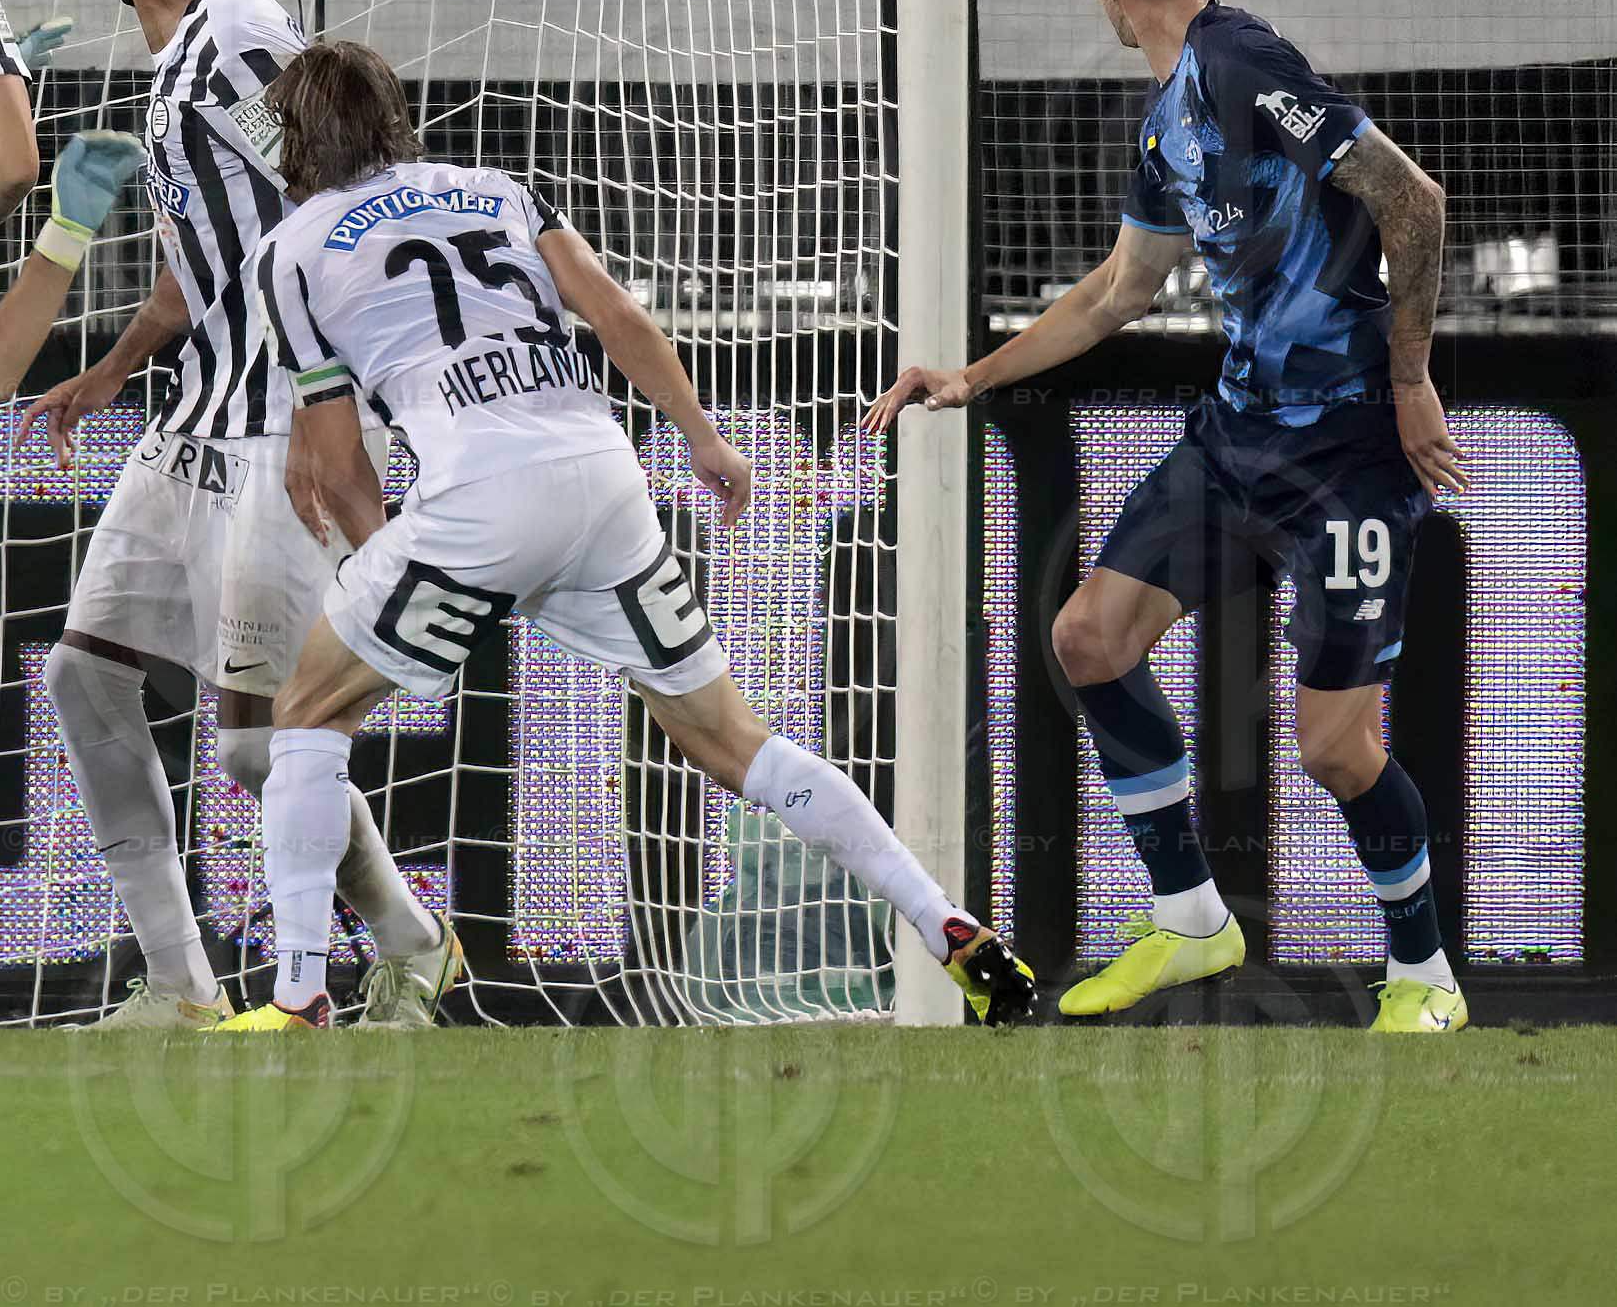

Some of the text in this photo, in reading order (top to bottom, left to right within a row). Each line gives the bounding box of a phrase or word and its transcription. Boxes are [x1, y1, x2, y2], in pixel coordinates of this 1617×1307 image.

[384, 228, 573, 350] 25
[437, 343, 605, 417] HIERLAND
[1325, 518, 1391, 590] 19
